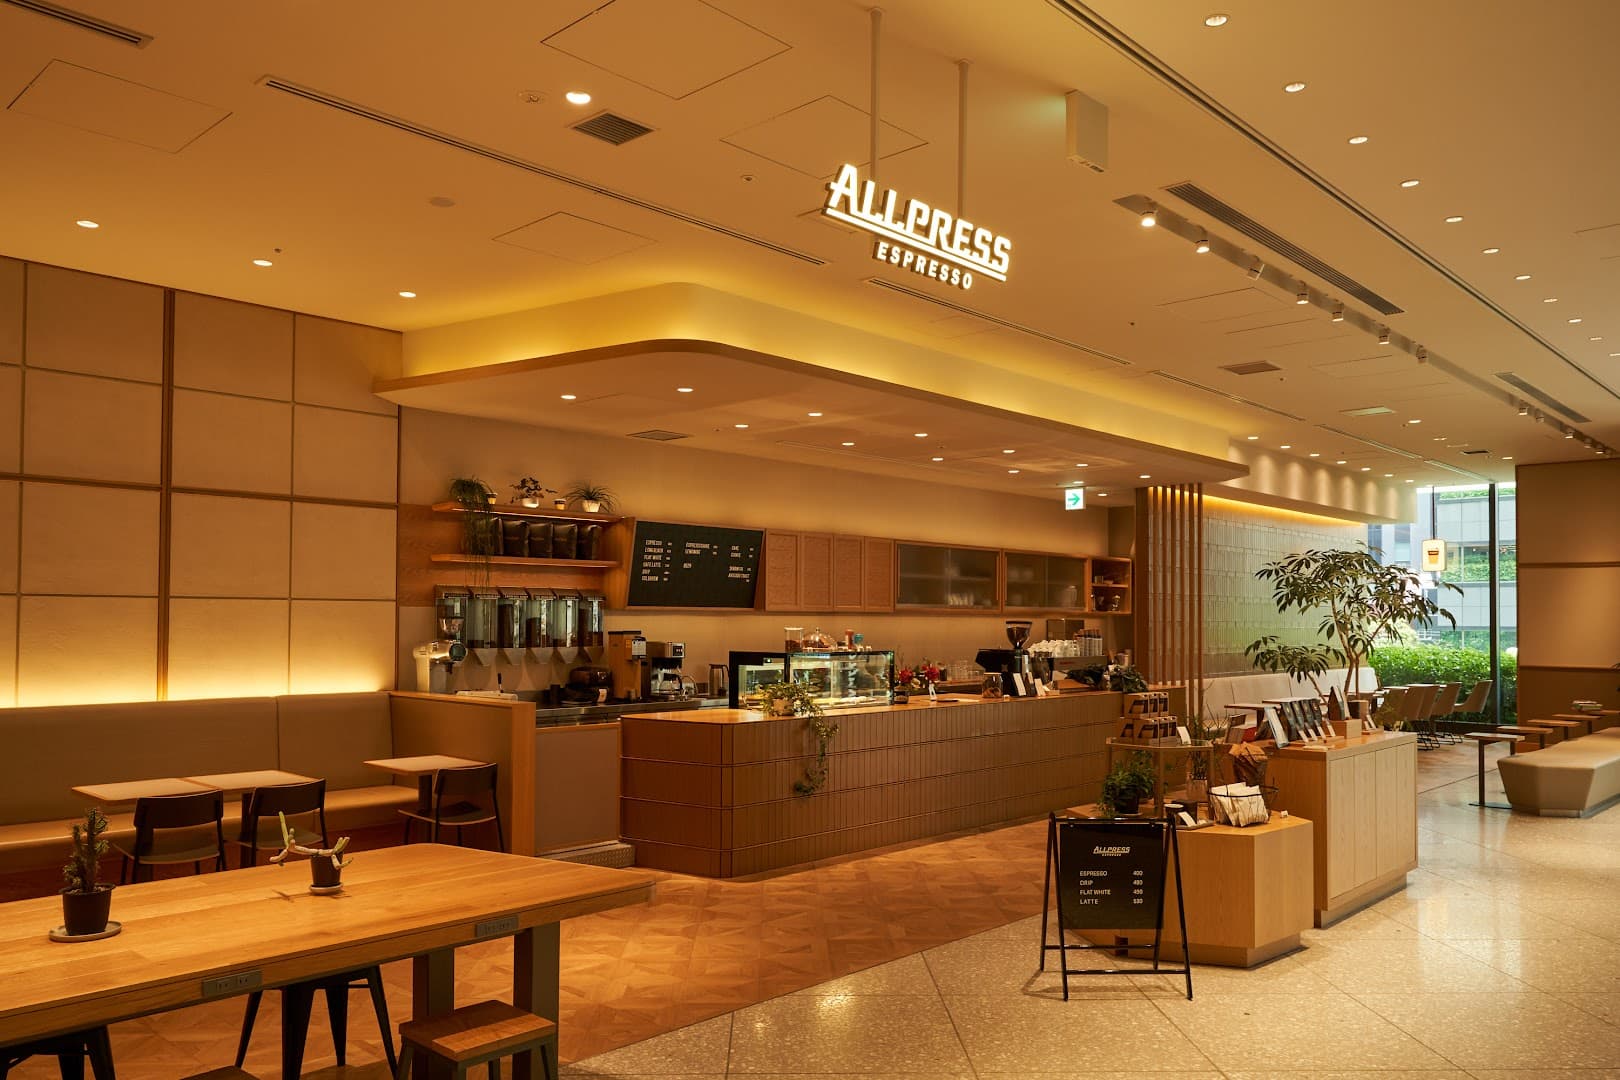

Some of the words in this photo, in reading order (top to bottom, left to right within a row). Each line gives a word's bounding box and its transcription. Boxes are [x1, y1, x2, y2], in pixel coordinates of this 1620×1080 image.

[827, 163, 1012, 274] ALLPRESS
[876, 241, 973, 289] ESPRESSO
[1093, 845, 1131, 854] ALLPRESS
